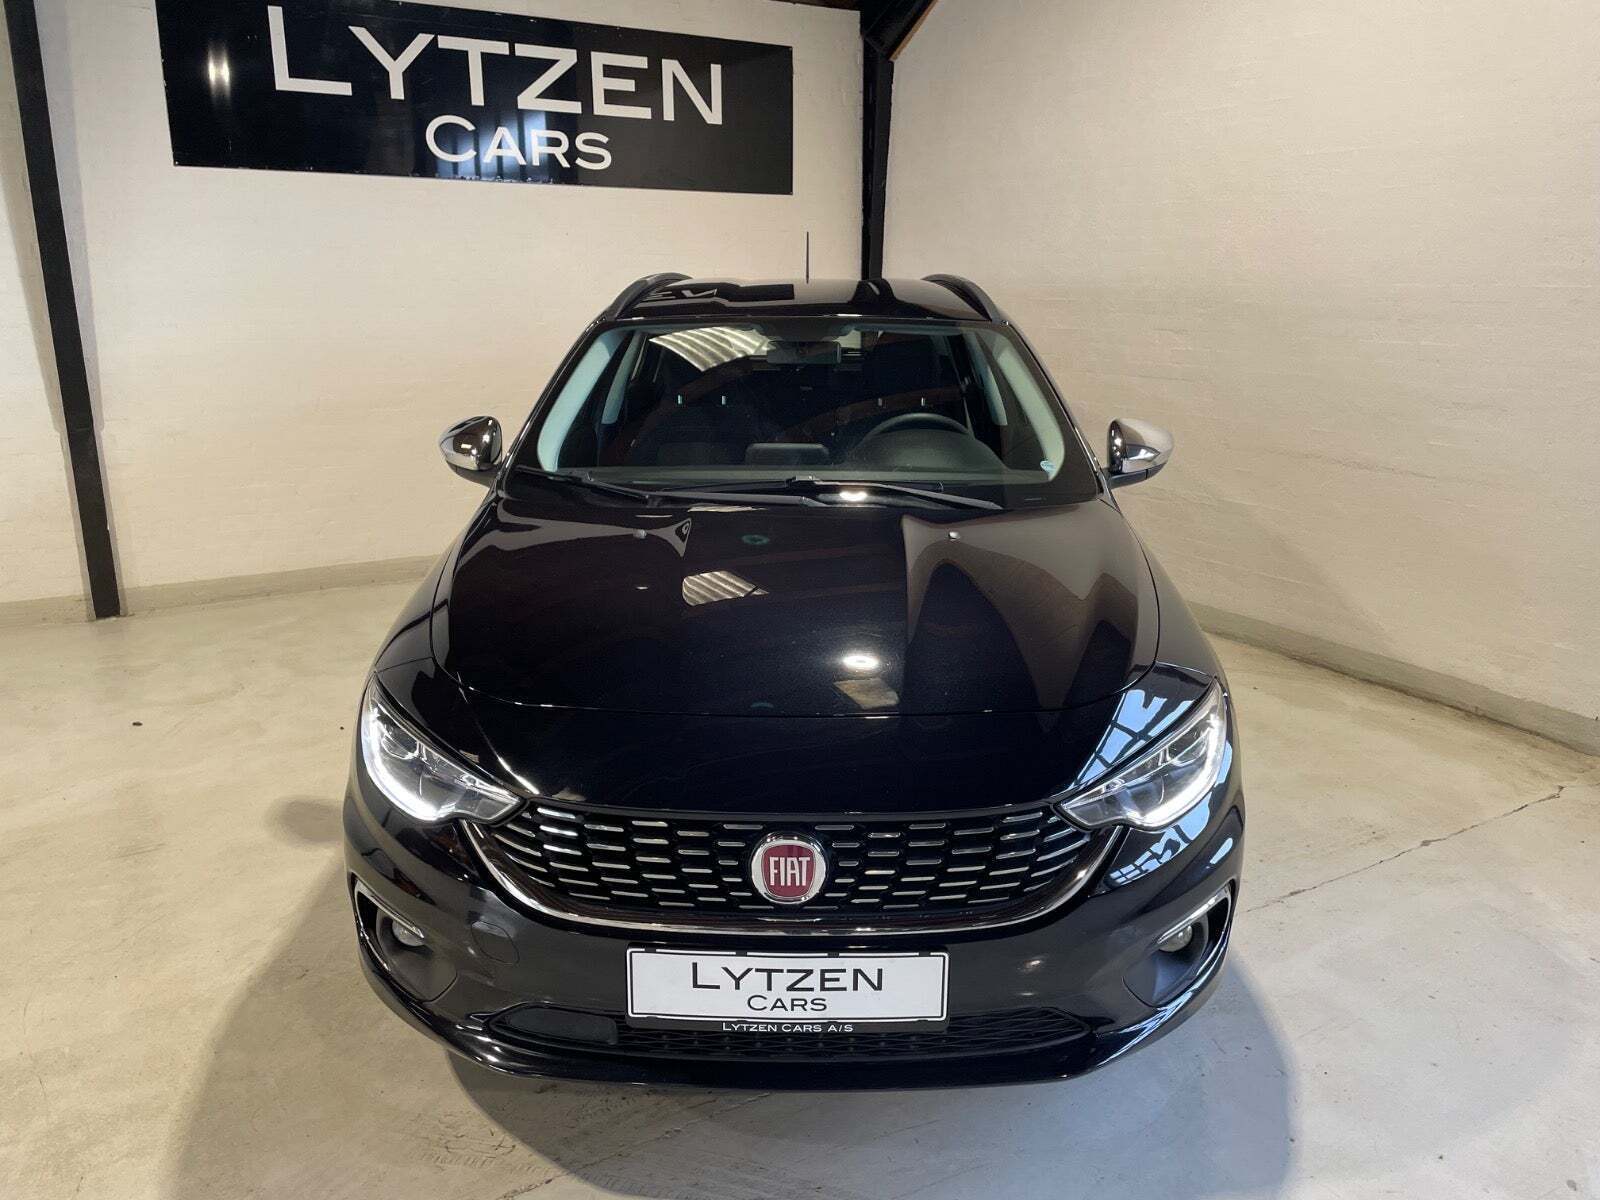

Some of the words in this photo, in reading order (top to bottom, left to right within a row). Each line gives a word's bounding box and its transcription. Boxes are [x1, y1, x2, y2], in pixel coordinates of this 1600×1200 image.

[267, 5, 722, 126] LYTZEN
[425, 114, 612, 170] CARS
[769, 857, 811, 887] FIAT
[692, 961, 883, 992] LYTZEN
[747, 995, 828, 1012] CARS
[722, 1022, 777, 1032] LYTZEN
[781, 1023, 823, 1033] CARS
[827, 1024, 854, 1033] A/S
